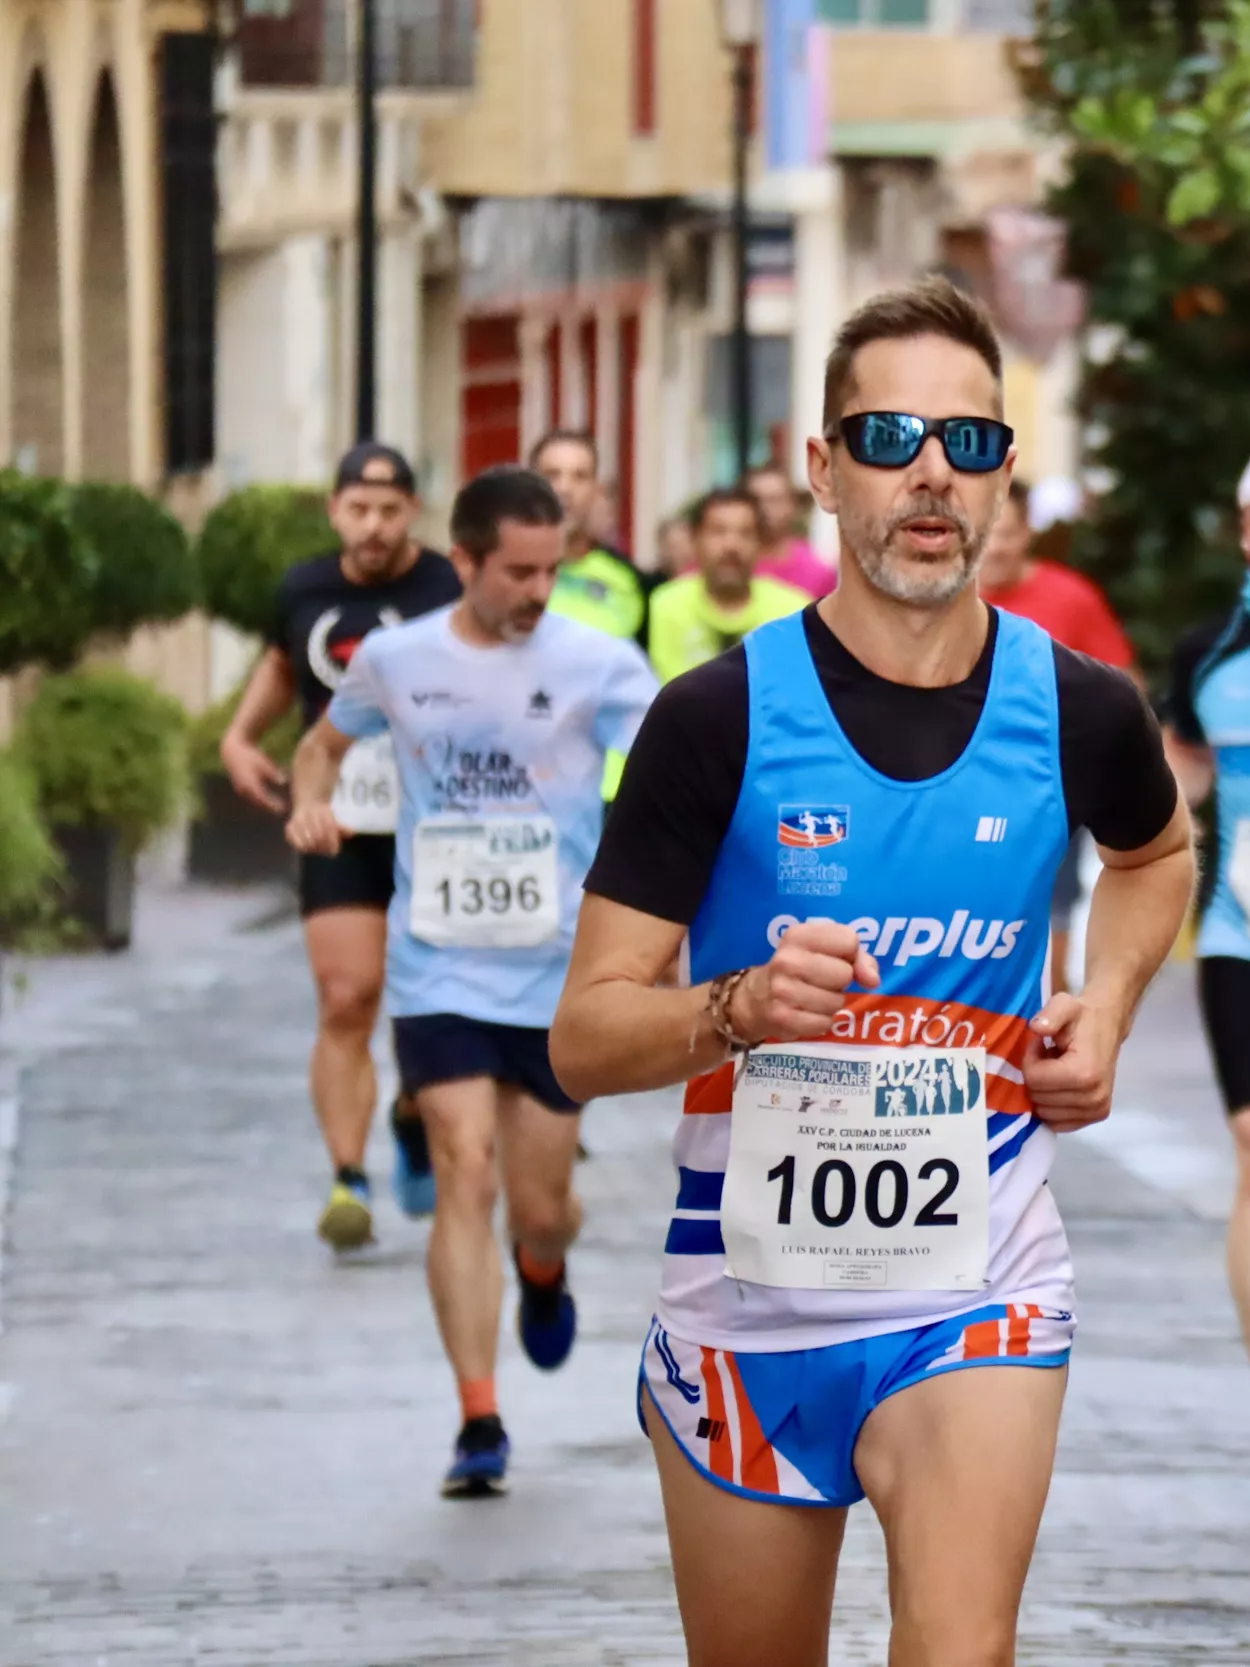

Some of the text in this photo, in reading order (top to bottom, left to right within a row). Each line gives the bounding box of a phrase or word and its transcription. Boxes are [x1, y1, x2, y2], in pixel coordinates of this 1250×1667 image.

[435, 877, 541, 916] 1396
[766, 910, 1024, 966] eerplus
[829, 1005, 975, 1048] aratón
[745, 1065, 872, 1087] CARRERAS POPULARES
[799, 1058, 856, 1073] PROVINCIAL
[858, 1062, 872, 1074] DE
[874, 1058, 938, 1087] 2024
[797, 1125, 931, 1138] XXV C.P. CIUDAD DE LUCENA
[816, 1142, 907, 1152] POR LA IGUALDAD
[767, 1155, 960, 1229] 1002
[781, 1246, 930, 1257] LUIS RAFAEL REYES BRAVO
